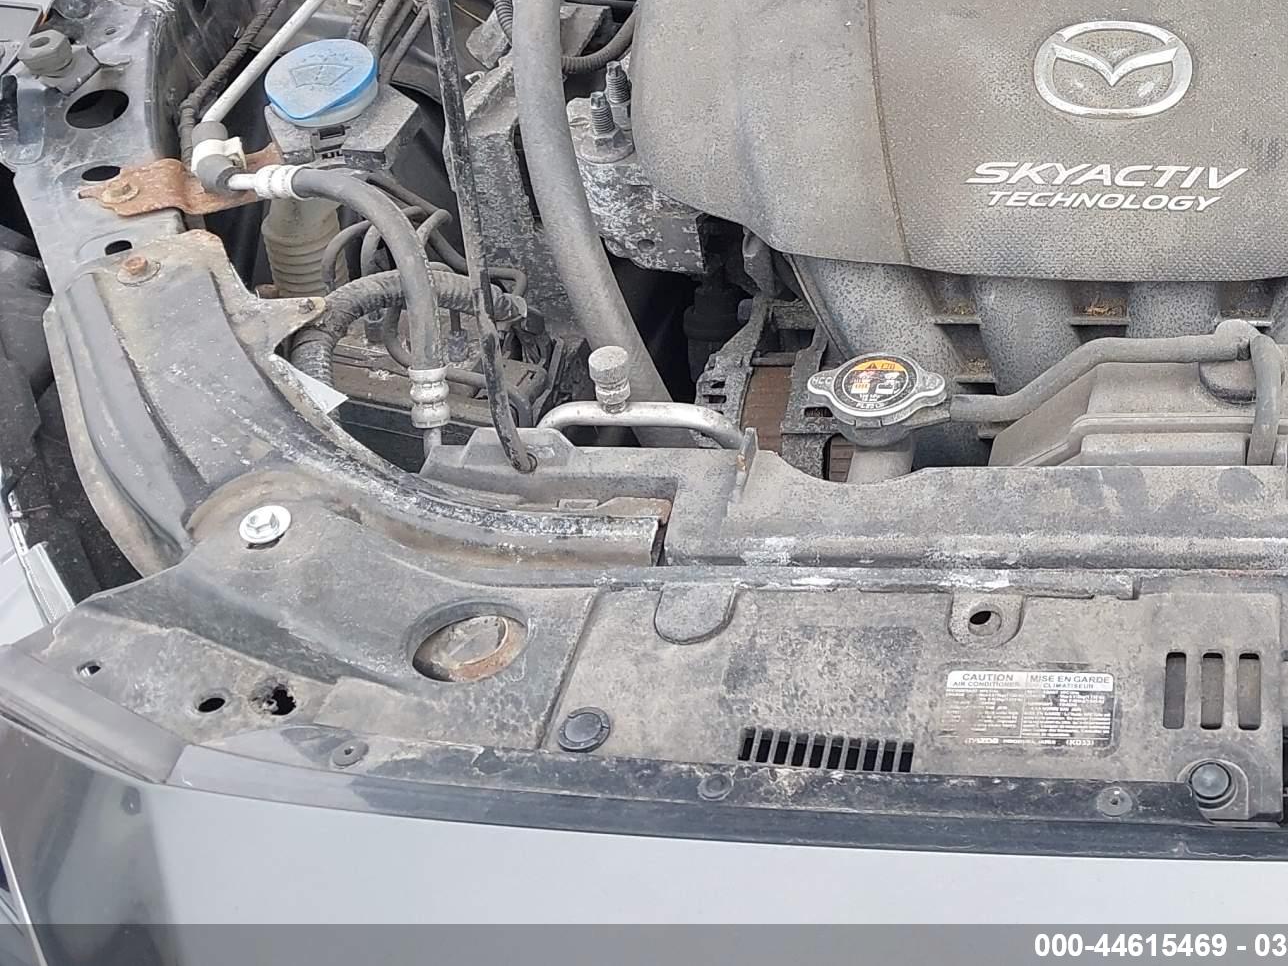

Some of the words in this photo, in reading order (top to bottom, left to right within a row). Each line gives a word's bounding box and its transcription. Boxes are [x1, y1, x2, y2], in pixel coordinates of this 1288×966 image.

[965, 162, 1249, 190] SKYACTIV
[987, 190, 1222, 212] TECHNOLOGY
[962, 673, 1014, 681] CAUTION
[1030, 674, 1054, 682] MISE
[1057, 675, 1071, 683] EN
[1073, 676, 1110, 684] GARDE
